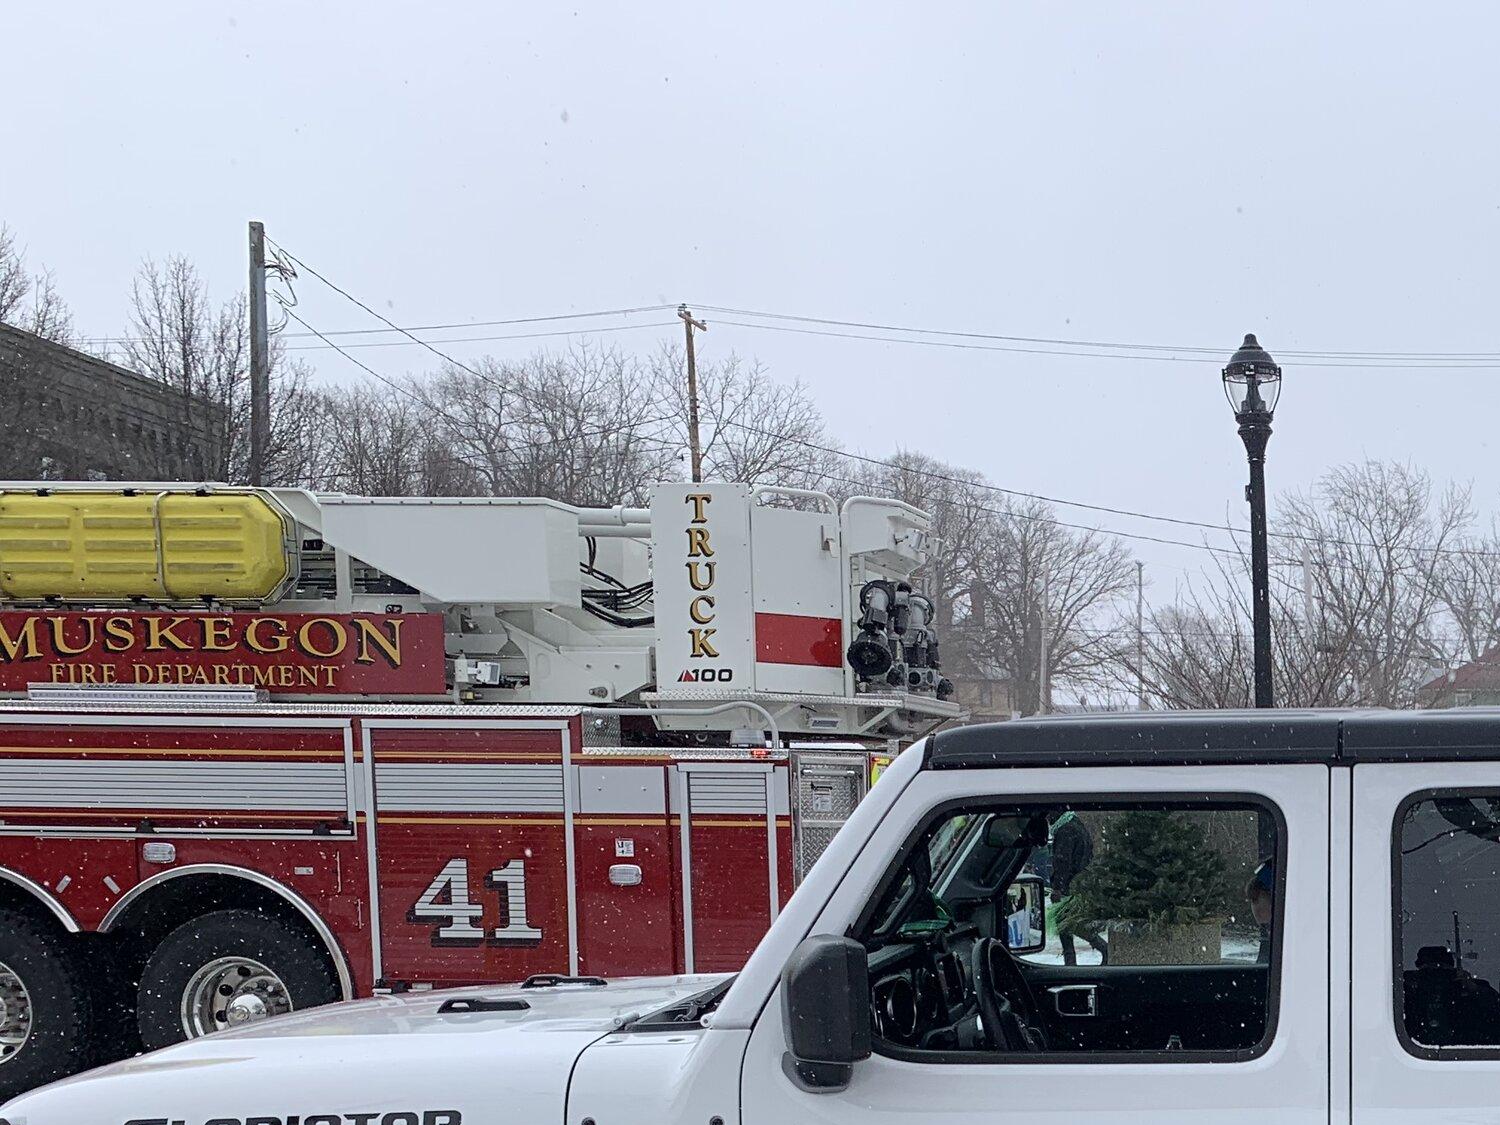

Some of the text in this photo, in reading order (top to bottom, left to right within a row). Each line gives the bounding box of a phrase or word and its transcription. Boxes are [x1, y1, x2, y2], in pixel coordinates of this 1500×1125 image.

[685, 494, 719, 657] TRUCK
[0, 616, 403, 665] MUSKEGON
[50, 663, 341, 687] FIRE DEPARTMENT
[411, 858, 543, 942] 41
